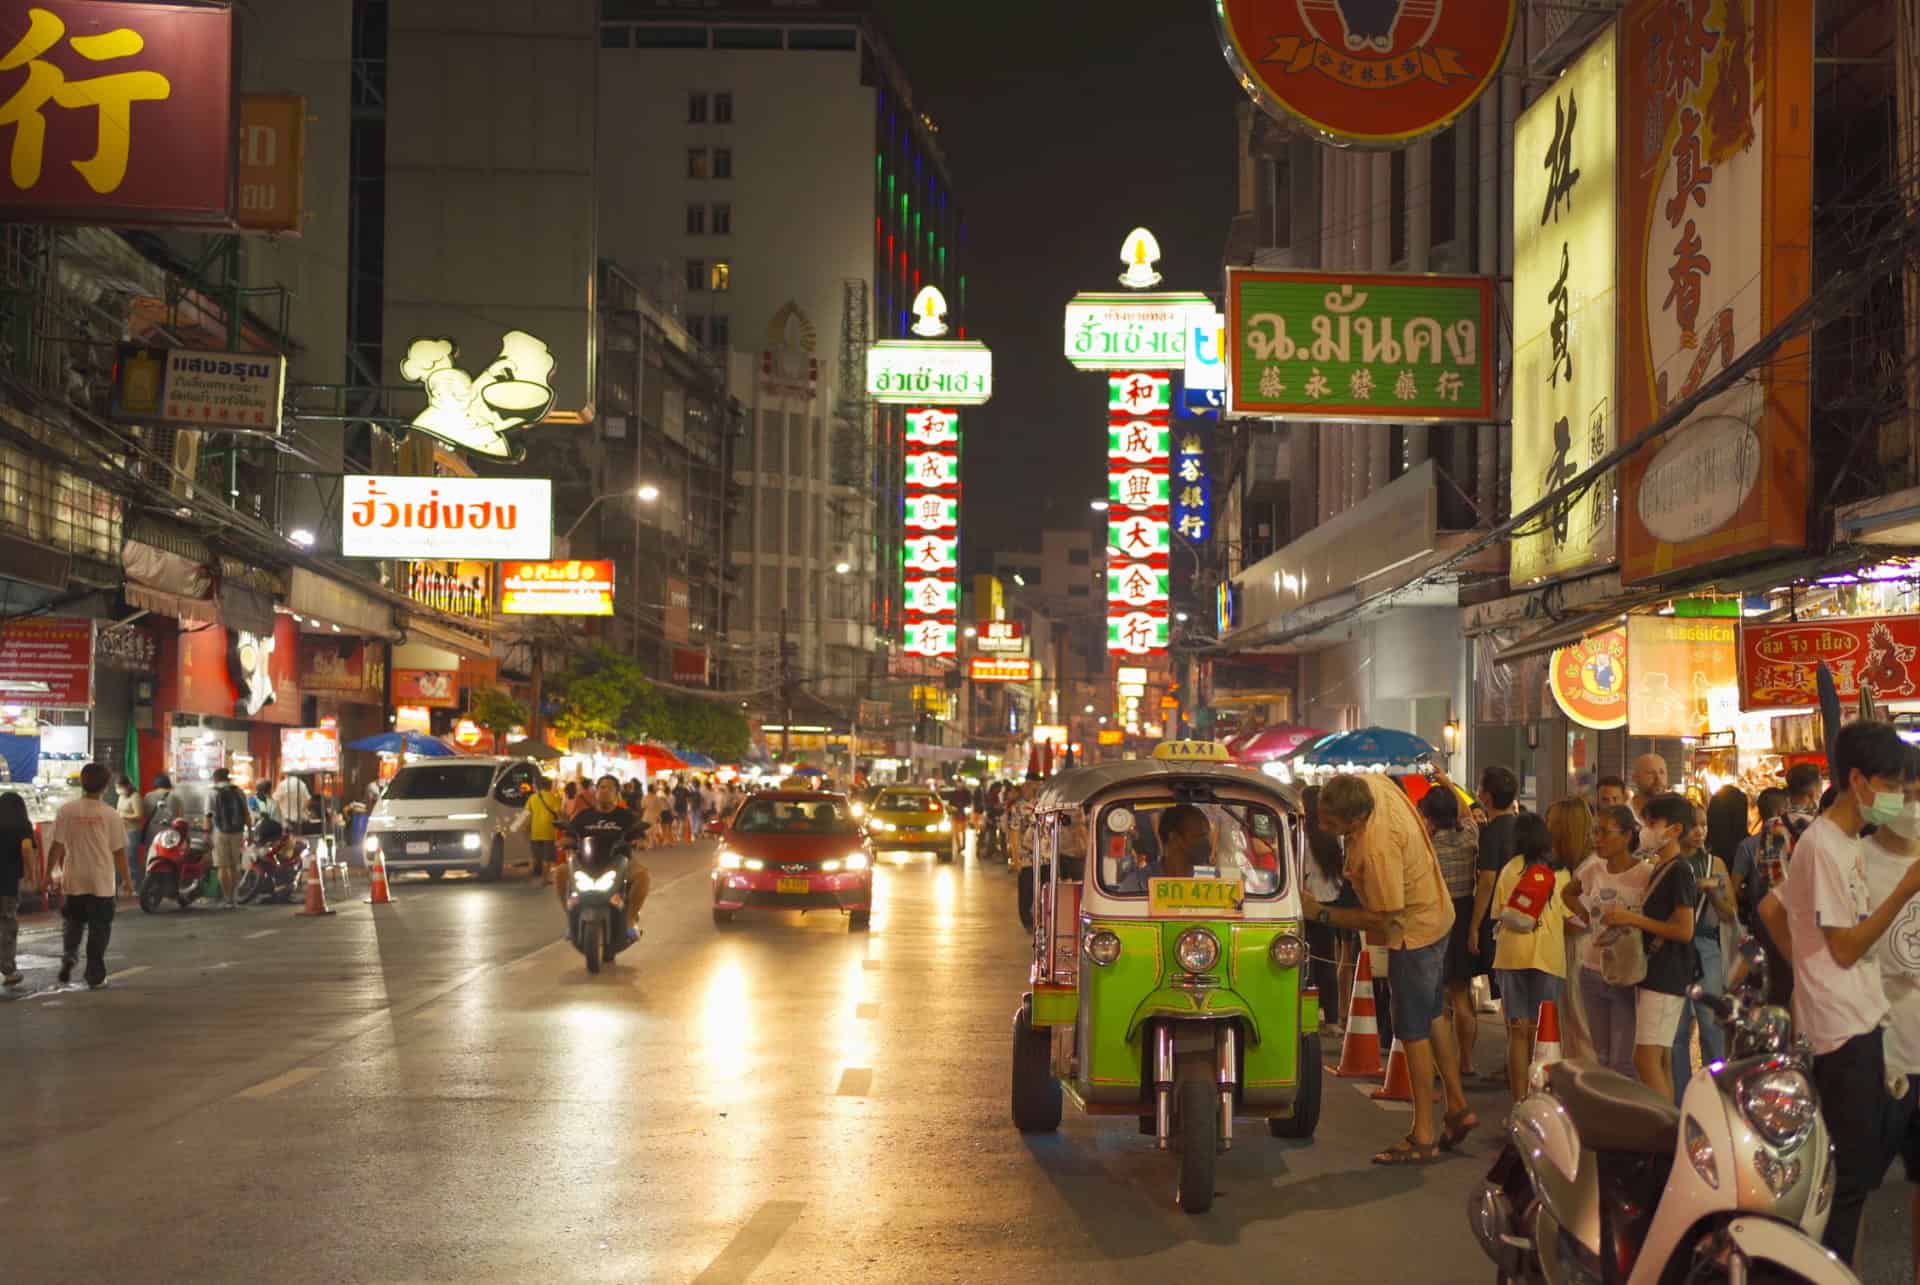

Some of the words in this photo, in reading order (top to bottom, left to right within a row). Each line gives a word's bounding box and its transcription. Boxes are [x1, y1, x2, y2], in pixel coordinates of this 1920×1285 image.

[0, 8, 171, 194] 行
[1247, 285, 1476, 364] ฉ.มั่นคง
[351, 479, 518, 529] ฮั่วเซ่งฮง
[920, 414, 945, 651] 和成興大金行
[1123, 378, 1152, 648] 和成興大金行
[1170, 744, 1215, 755] TAXI
